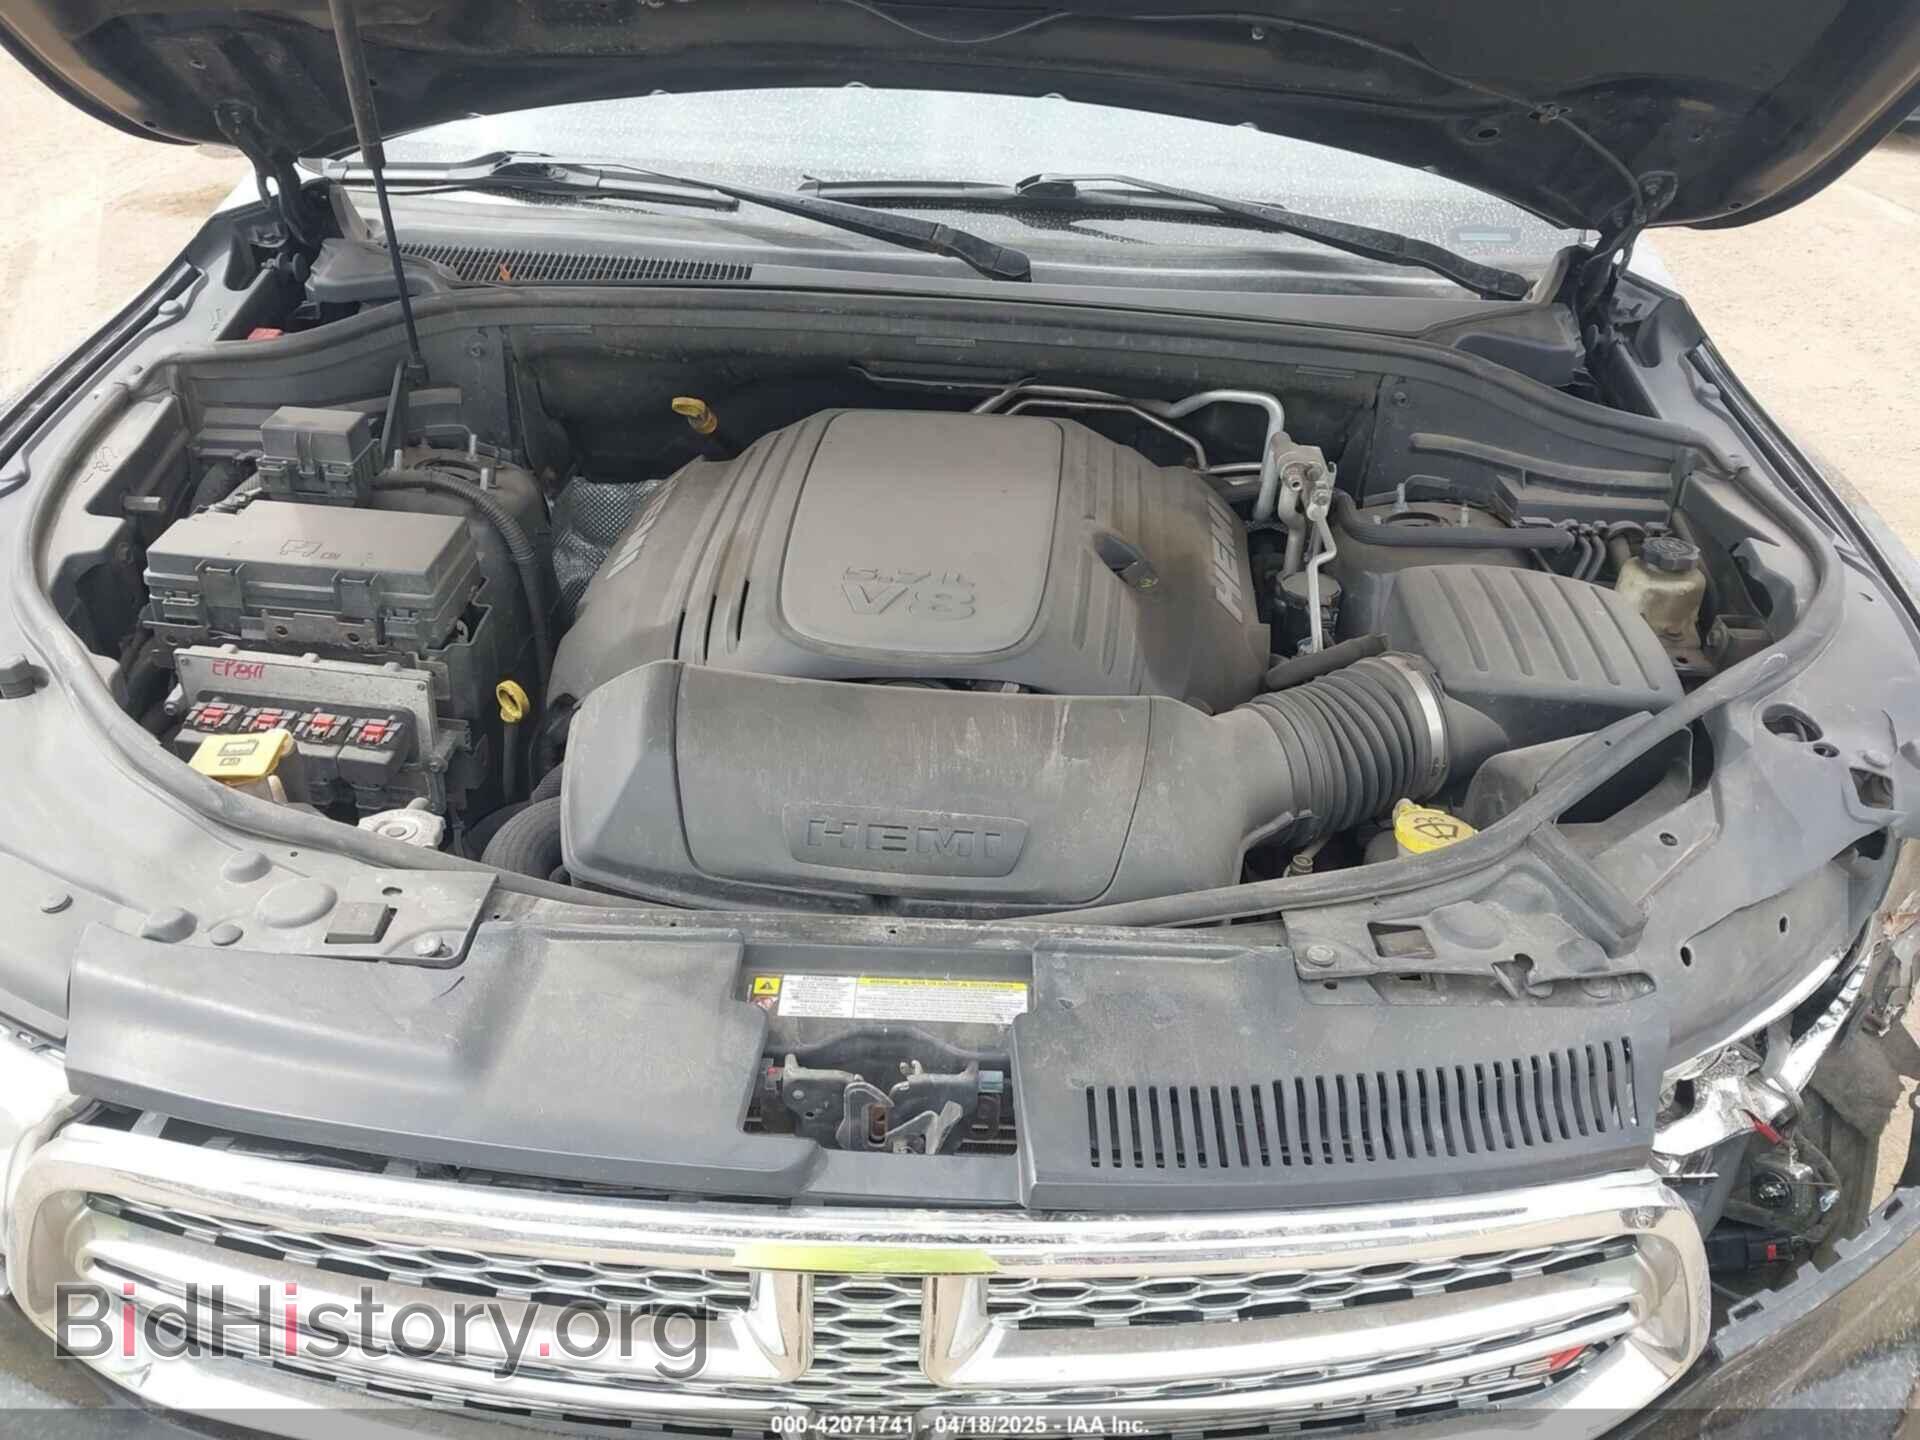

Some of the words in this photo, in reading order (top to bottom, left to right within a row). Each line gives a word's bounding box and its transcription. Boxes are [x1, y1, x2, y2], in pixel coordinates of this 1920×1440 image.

[1206, 494, 1243, 624] HEMI
[841, 583, 977, 622] V8
[803, 818, 1003, 858] HEMI
